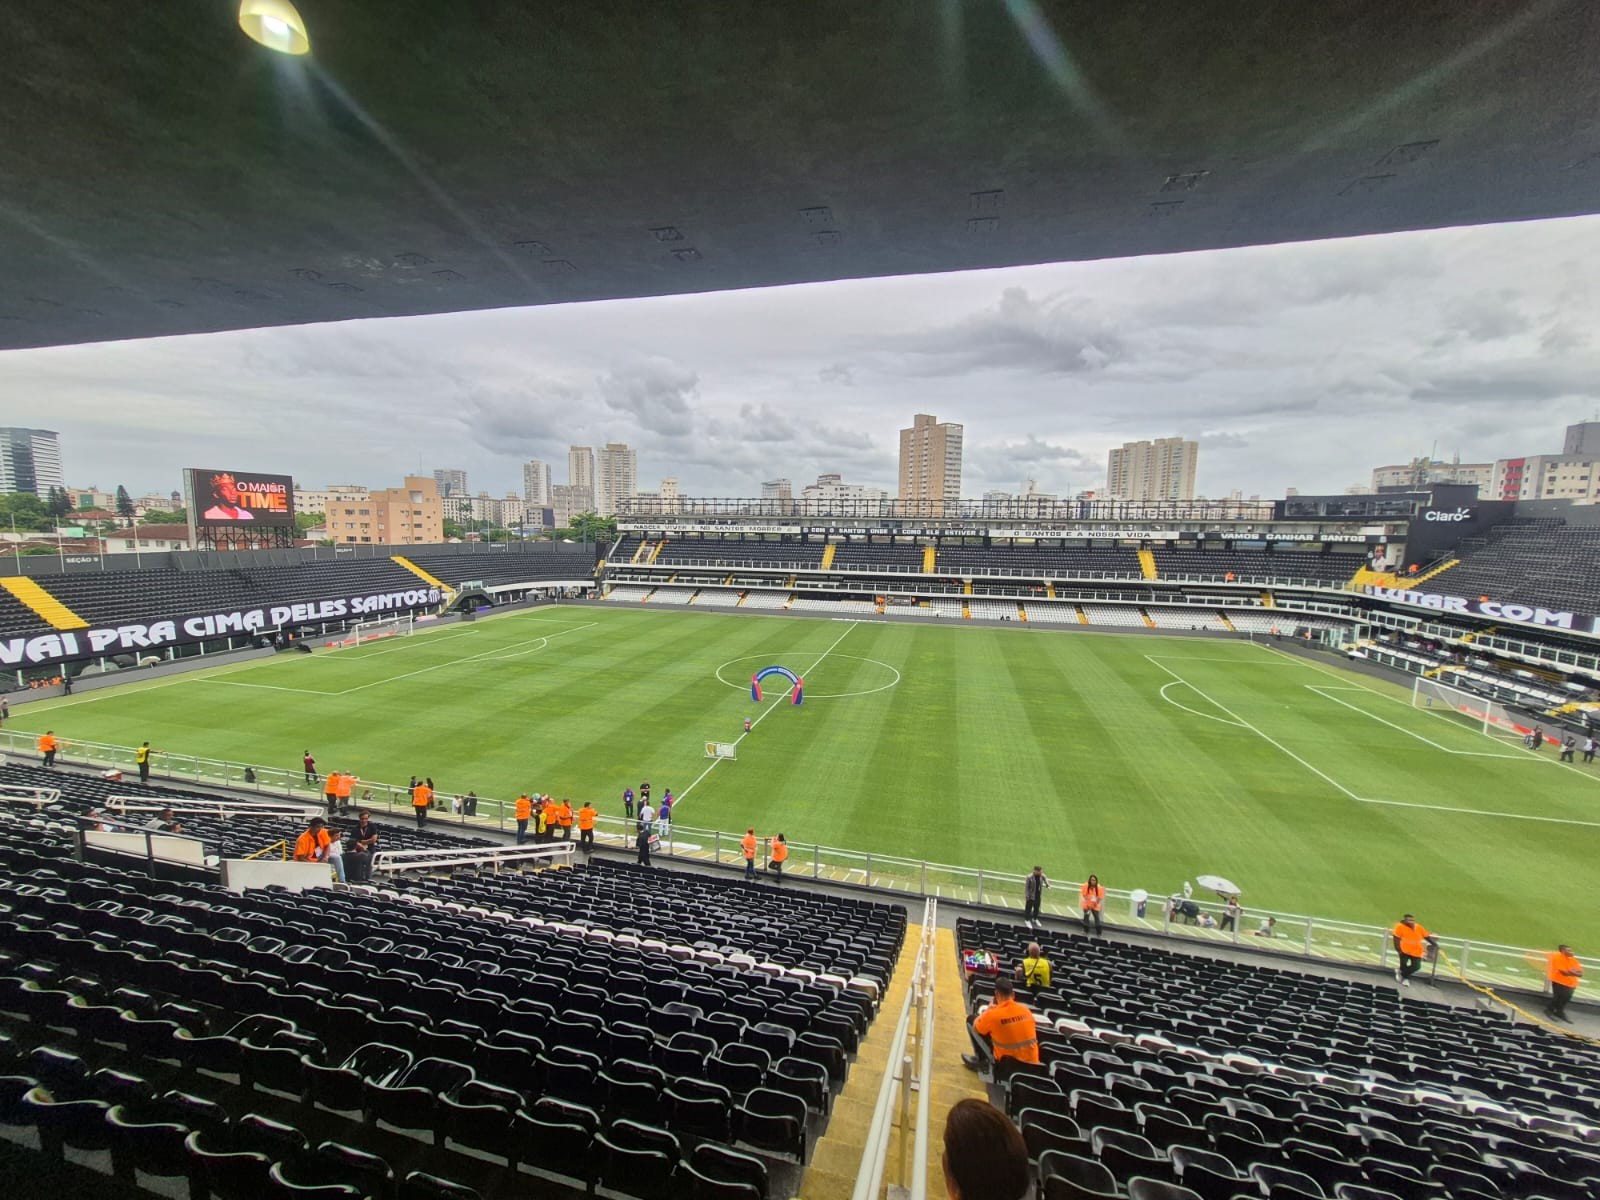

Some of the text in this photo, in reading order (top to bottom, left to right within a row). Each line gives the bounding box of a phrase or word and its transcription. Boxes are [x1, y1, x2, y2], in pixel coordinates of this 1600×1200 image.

[237, 482, 286, 493] O MAIOR
[239, 491, 288, 509] TIME
[1425, 510, 1464, 521] Claro
[1320, 534, 1367, 542] SANTOS
[66, 556, 92, 564] SEÇÃO
[1374, 586, 1470, 613] LUTAR
[1479, 602, 1573, 629] COM
[0, 589, 428, 664] VAI PRA CIMA DELES SANTOS
